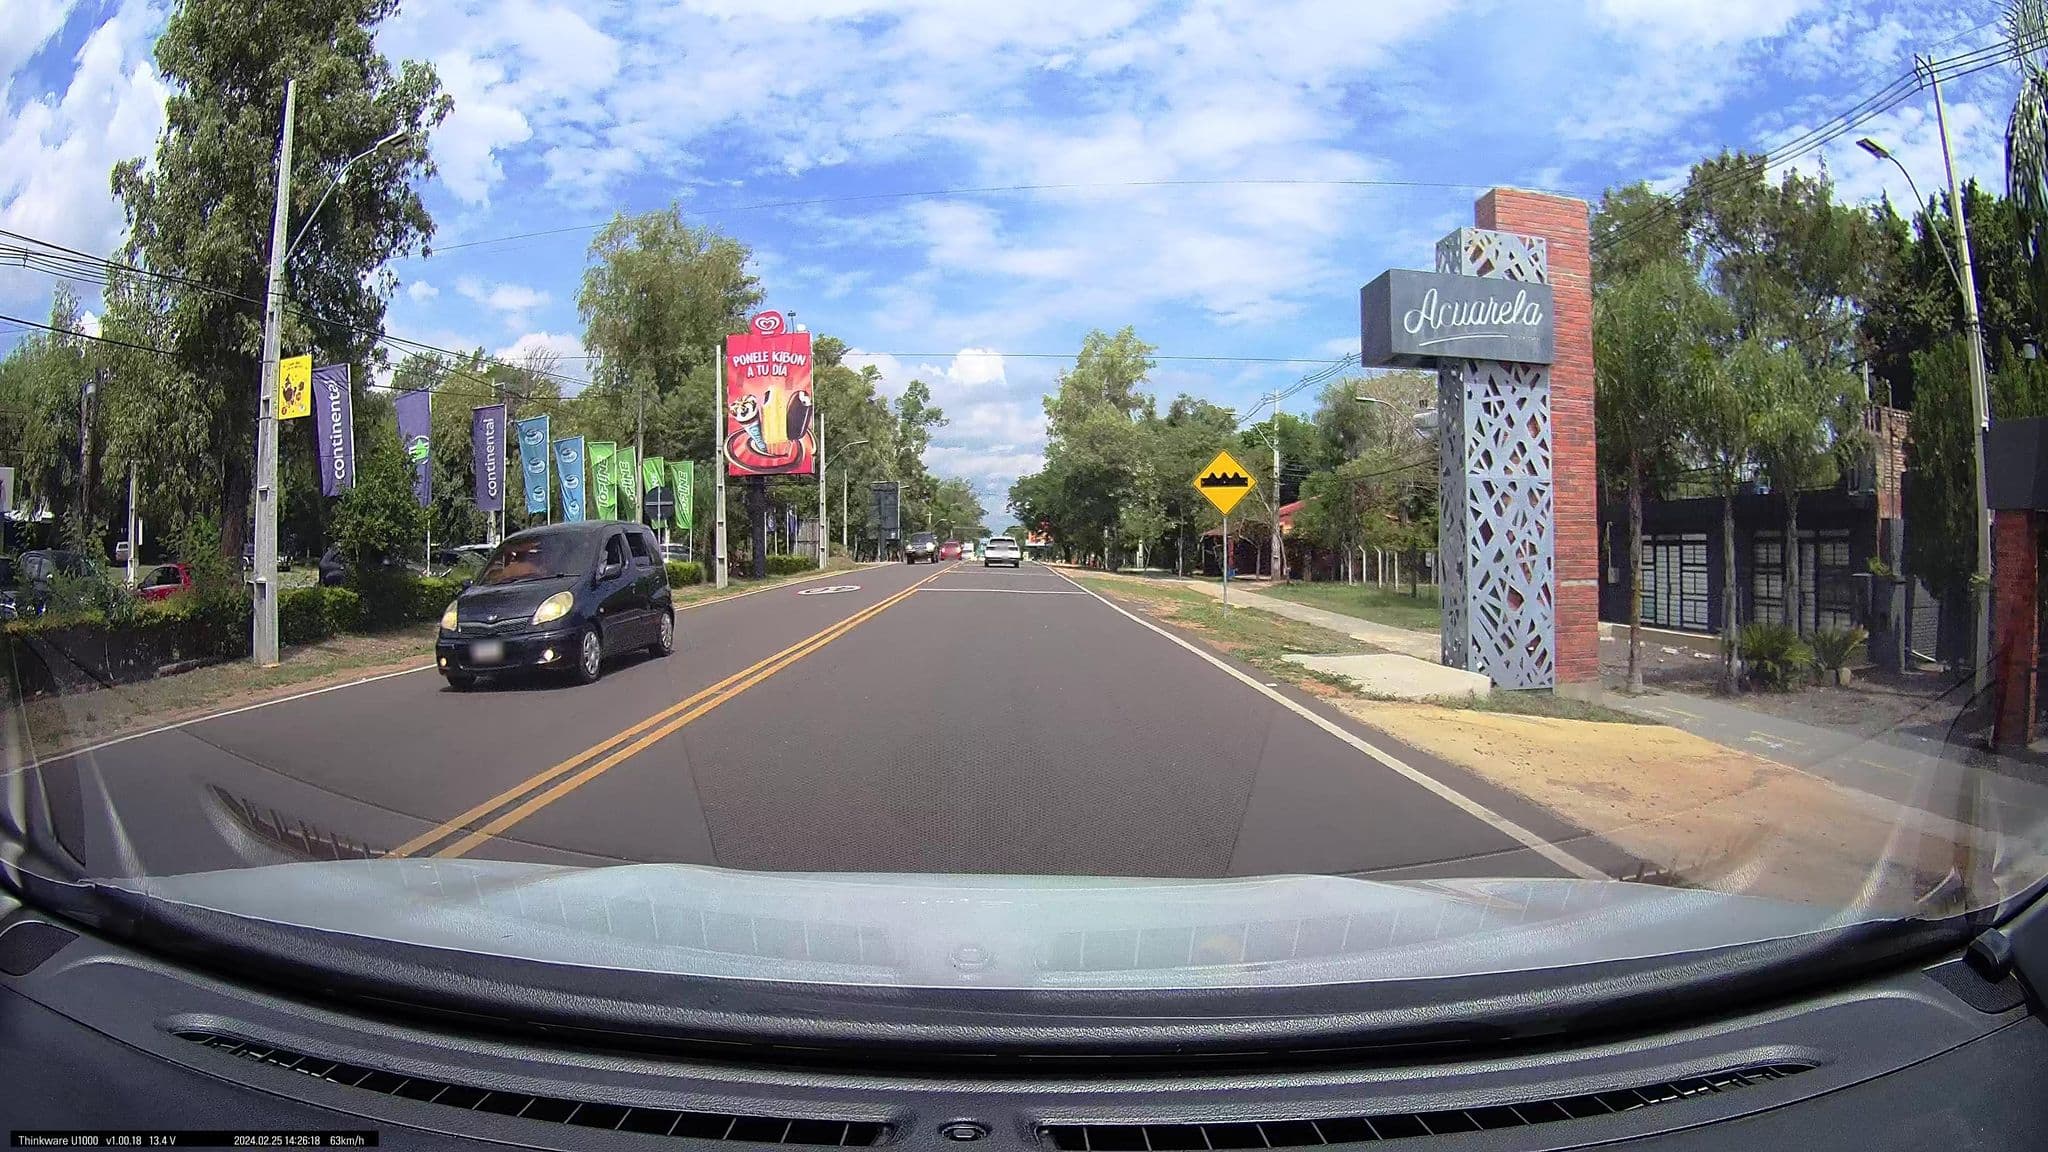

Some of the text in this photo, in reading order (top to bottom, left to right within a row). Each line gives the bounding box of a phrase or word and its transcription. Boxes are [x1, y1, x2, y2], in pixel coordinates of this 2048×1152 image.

[1403, 288, 1543, 334] Acuarela
[732, 351, 806, 368] PONELE KIBON
[747, 366, 755, 378] A
[756, 364, 769, 376] TU
[483, 418, 497, 497] continental
[597, 456, 609, 508] TOPLINE
